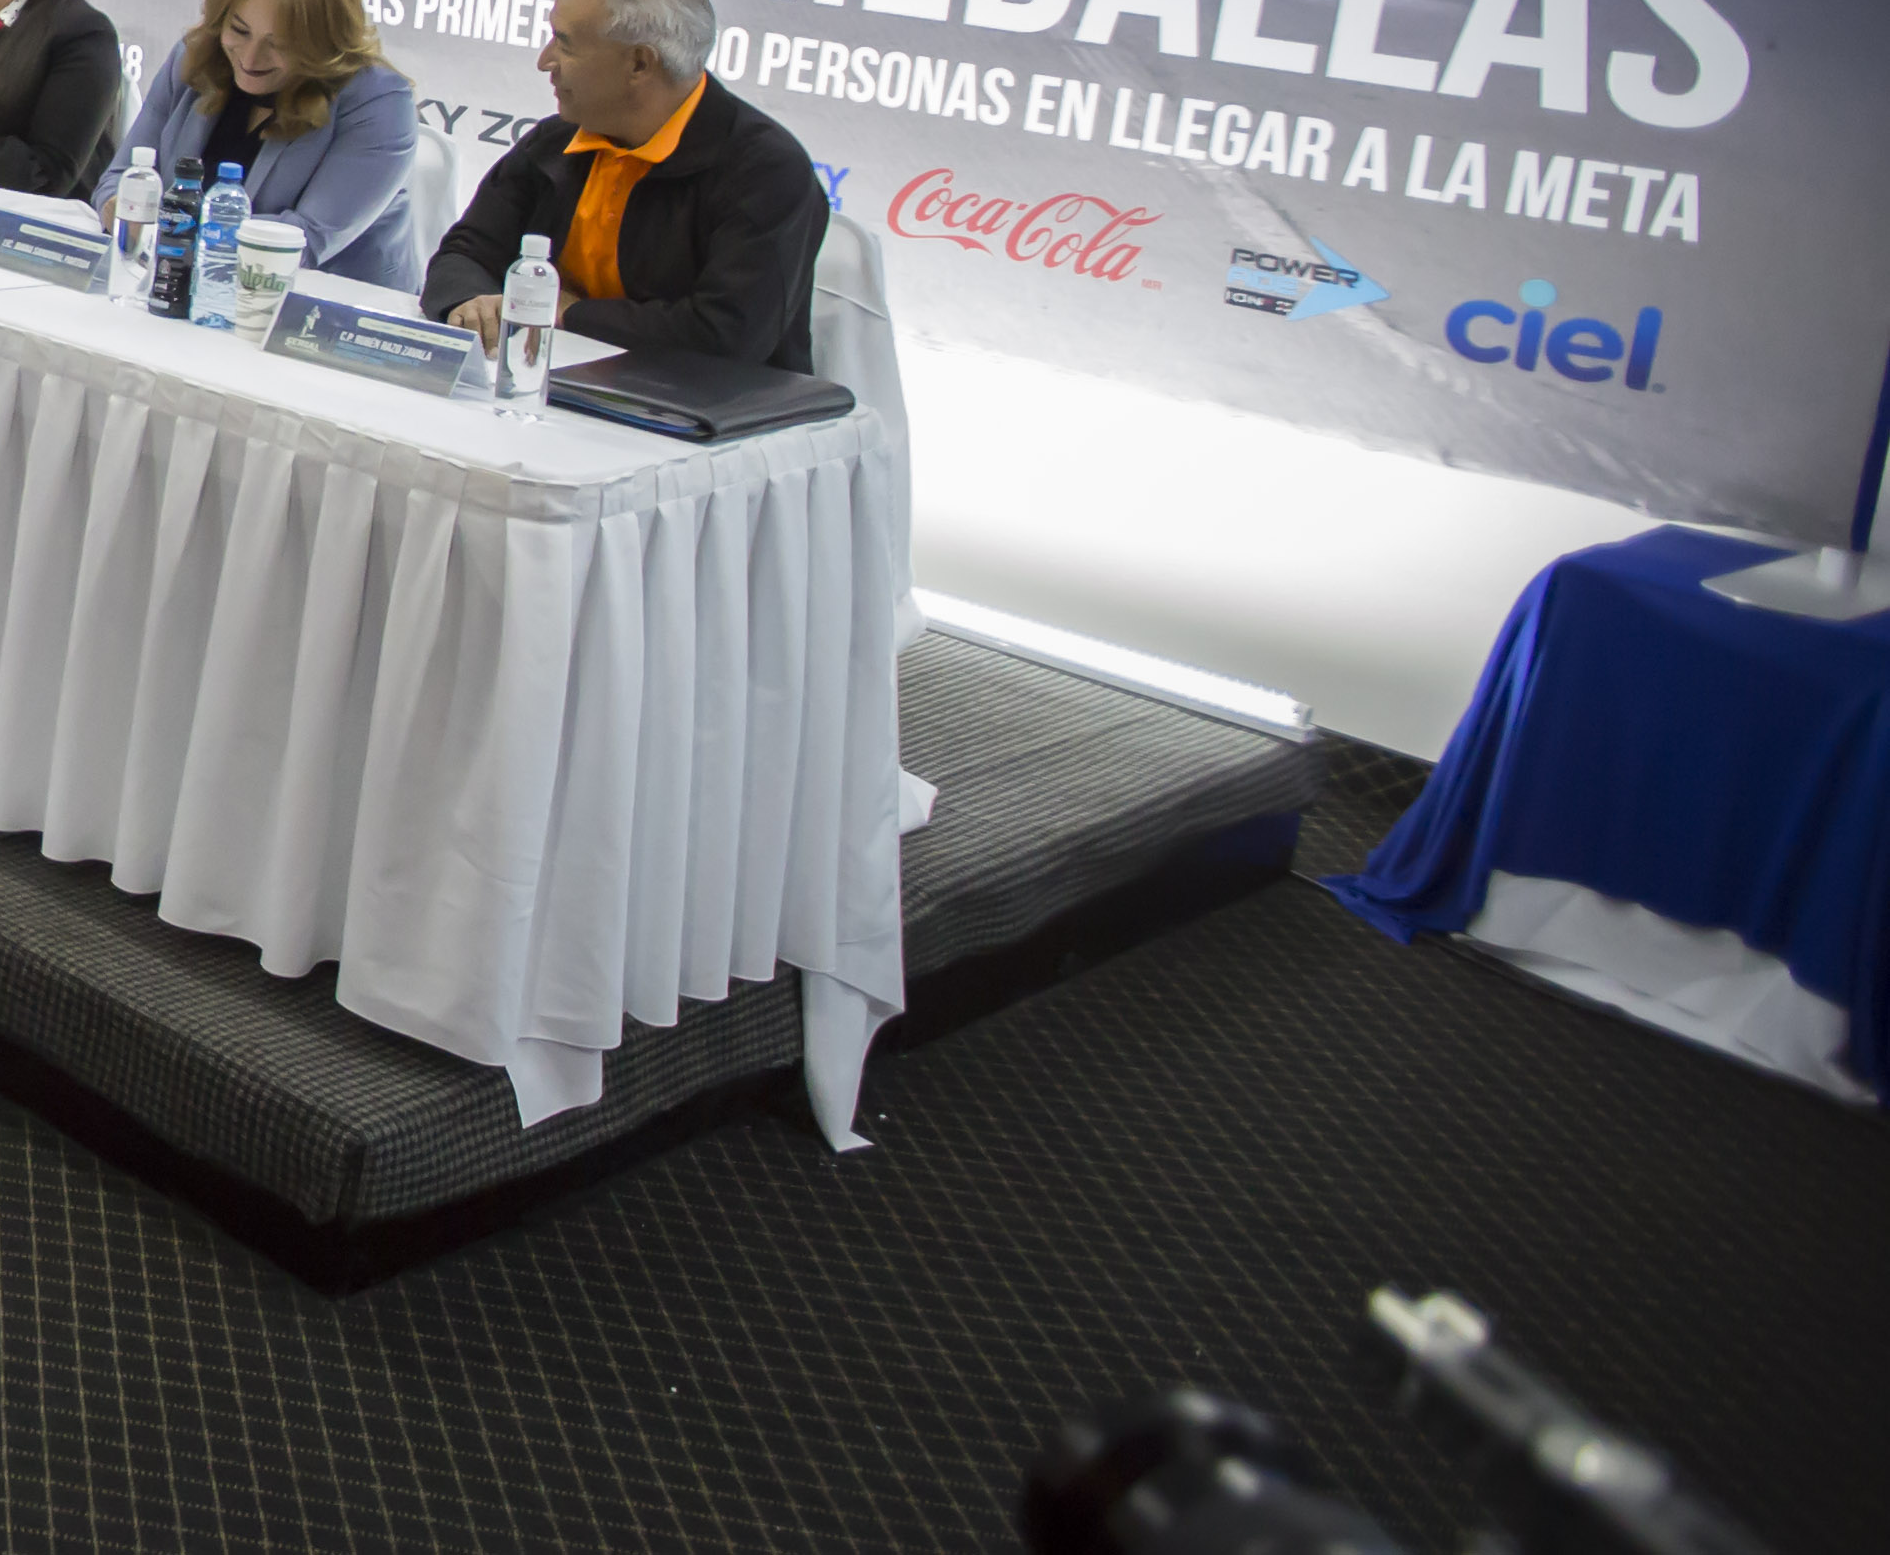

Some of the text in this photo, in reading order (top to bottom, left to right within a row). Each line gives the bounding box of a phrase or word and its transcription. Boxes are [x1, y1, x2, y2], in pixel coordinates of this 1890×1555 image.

[757, 31, 1014, 127] PERSONAS
[1023, 72, 1101, 141] EN
[1109, 86, 1338, 183] LLEGAR
[1342, 126, 1389, 194] A
[1405, 133, 1488, 210] LA
[1503, 149, 1700, 243] META
[887, 167, 1165, 283] Coca-Cola
[1231, 247, 1360, 289] POWER
[1444, 277, 1665, 393] ciel
